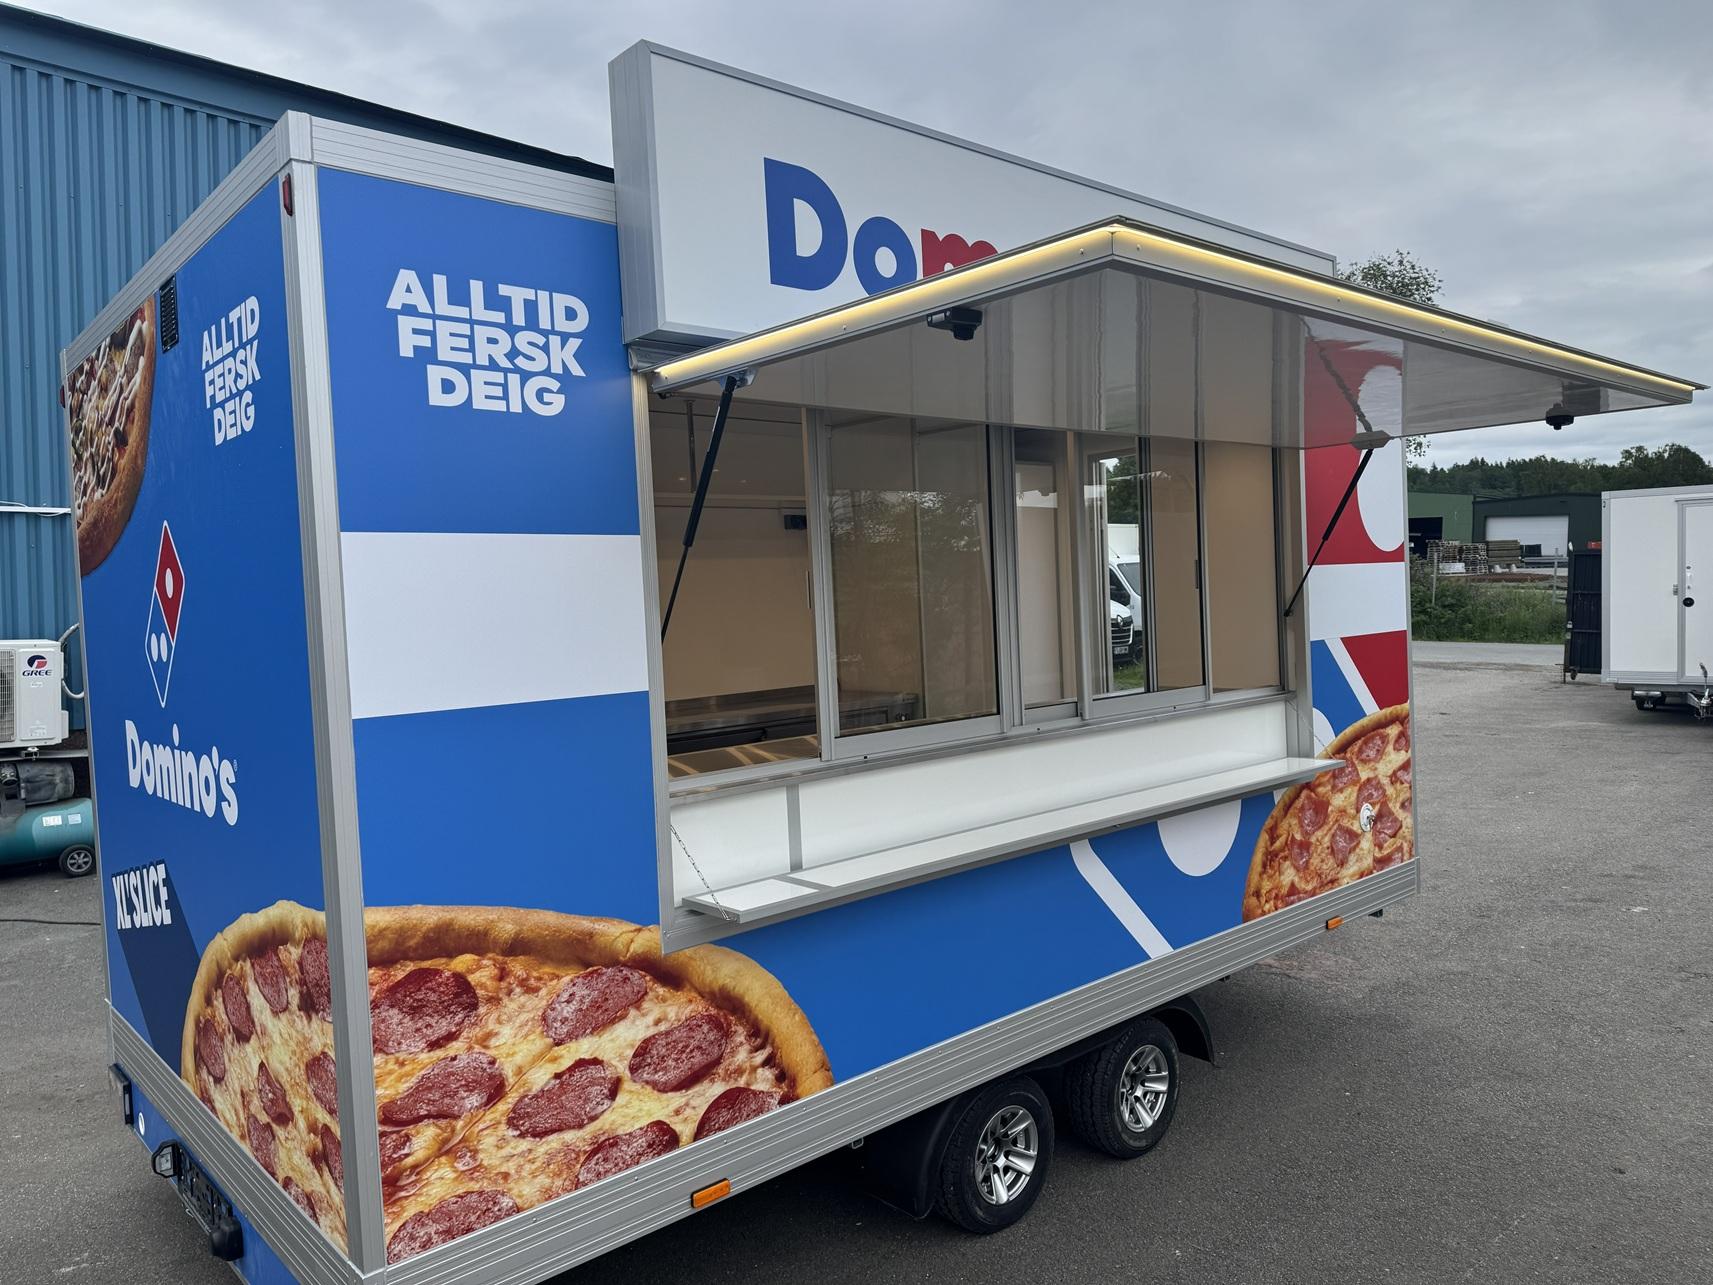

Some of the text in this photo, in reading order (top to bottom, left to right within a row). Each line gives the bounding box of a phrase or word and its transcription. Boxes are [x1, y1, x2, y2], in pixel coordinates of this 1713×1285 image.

[201, 295, 260, 370] ALLTID
[386, 268, 590, 333] ALLTID
[204, 338, 261, 409] FERSK
[397, 314, 586, 377] FERSK
[213, 390, 255, 446] DEIG
[426, 364, 566, 416] DEIG
[22, 669, 53, 677] GREE
[125, 719, 238, 826] Domino's
